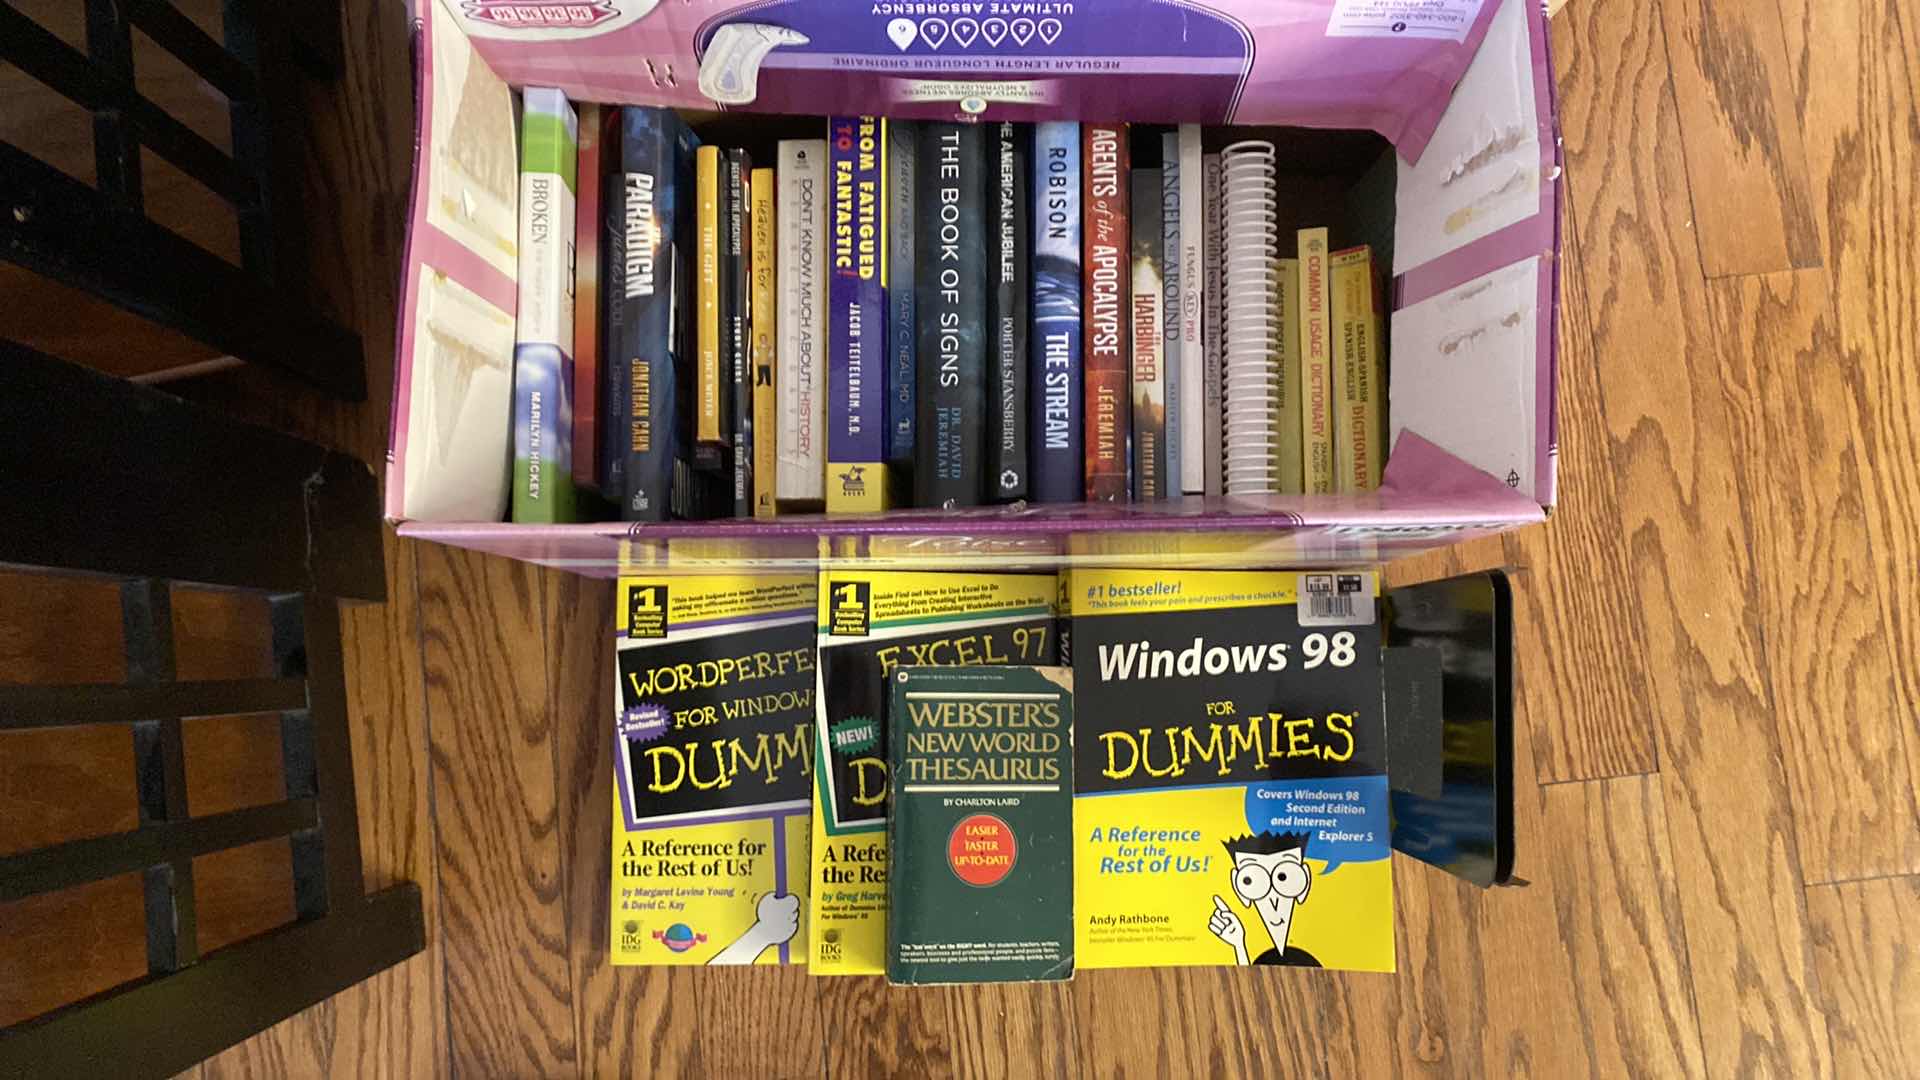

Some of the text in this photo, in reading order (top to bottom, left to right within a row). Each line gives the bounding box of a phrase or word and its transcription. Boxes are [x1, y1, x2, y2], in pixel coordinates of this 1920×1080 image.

[871, 2, 1074, 15] ULTIMATE ABSORBENCY
[832, 57, 1120, 70] REGULAR LENGTH LONGUEUR ORDINAIRE
[730, 161, 741, 187] AGENTS
[1001, 141, 1014, 219] AMERICAN
[1208, 162, 1220, 190] One
[836, 126, 859, 277] TO FANTASTIC!
[859, 116, 875, 280] FROM FATIGUED
[1048, 147, 1067, 239] ROBISON
[1163, 160, 1180, 240] ANGELS
[531, 178, 550, 245] BROKEN
[624, 172, 655, 299] PARADIGM
[731, 214, 742, 256] APOCALYPSE
[1091, 129, 1118, 357] AGENTS of the APOCALYPSE
[1208, 229, 1220, 261] With
[940, 131, 960, 388] THE BOOK OF SIGNS
[1001, 222, 1014, 283] JUBILEE
[1186, 245, 1196, 289] FUNGUS
[703, 254, 713, 284] GIFT
[1206, 265, 1220, 300] Jesus
[899, 293, 911, 327] MARY
[1163, 260, 1181, 342] AROUND
[800, 178, 813, 458] DON'T KNOW MUCH ABOUT HISTORY
[849, 302, 862, 337] JACOB
[1185, 320, 1195, 343] PRO
[1135, 293, 1156, 383] HARBINGER
[1208, 324, 1220, 350] The
[1308, 255, 1325, 438] COMMON USAGE DICTIONARY
[899, 383, 911, 401] MD
[1001, 317, 1015, 452] PORTER STANSBERRY
[1045, 331, 1069, 449] THE STREAM
[1205, 352, 1220, 408] Gospels
[631, 358, 650, 452] JONATHAN CAHN
[1097, 385, 1114, 460] JEREMIAH
[529, 391, 542, 500] MARILYN HICKEY
[937, 407, 949, 479] JEREMIAH
[950, 407, 962, 479] DR. DAVID
[1351, 405, 1368, 489] DICTIONARY
[1087, 580, 1182, 599] #1 bestseller!
[1204, 594, 1246, 605] prescribes
[876, 634, 1009, 679] EXCEL
[1012, 625, 1047, 660] 97
[1097, 637, 1289, 681] Windows
[1301, 631, 1357, 670] 98
[628, 648, 815, 699] WORDPERFE
[628, 709, 659, 722] Revised
[673, 688, 815, 731] FOR WINDOW
[906, 701, 1061, 728] WEBSTER'S
[1205, 700, 1236, 717] FOR
[835, 724, 874, 748] NEW!
[906, 732, 1061, 754] NEW WORLD
[1097, 711, 1356, 780] DUMMIES
[644, 722, 815, 795] DUMM
[905, 757, 1061, 781] THESAURUS
[943, 797, 1020, 807] BY CHARLTON LAIRD
[1256, 788, 1361, 802] Covers Windows 98
[1286, 801, 1366, 816] Second Edition
[965, 825, 999, 836] EASIER
[1089, 826, 1201, 843] A Reference
[1270, 815, 1337, 828] and Internet
[1318, 830, 1374, 844] Explorer 5
[621, 837, 768, 858] A Reference for
[822, 844, 888, 864] A Refe
[954, 855, 1009, 866] UP-TO-DATE
[1117, 844, 1166, 859] for the
[622, 858, 754, 878] the Rest of Us!
[822, 865, 888, 884] the Re
[1100, 855, 1210, 875] Rest of Us!
[622, 887, 633, 898] by
[634, 887, 675, 899] Margaret
[708, 886, 736, 898] Young
[631, 900, 657, 911] David
[669, 901, 686, 912] Kay
[1089, 914, 1170, 927] Andy Rathbone
[622, 934, 641, 945] IDG
[821, 943, 842, 955] IDG
